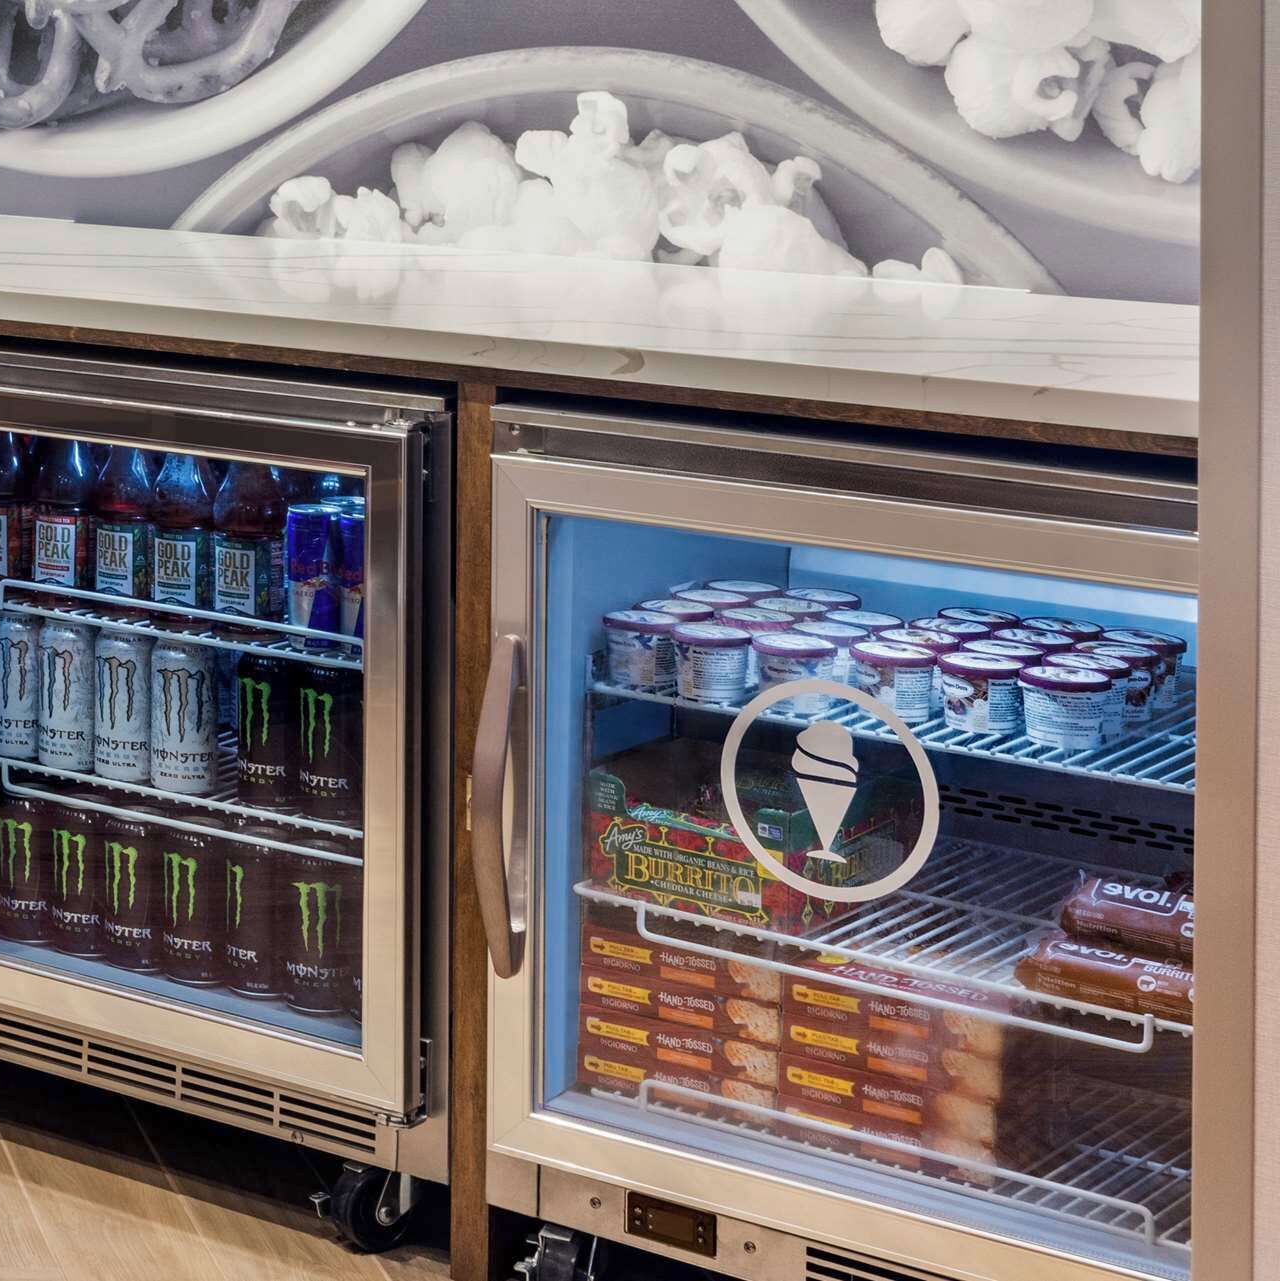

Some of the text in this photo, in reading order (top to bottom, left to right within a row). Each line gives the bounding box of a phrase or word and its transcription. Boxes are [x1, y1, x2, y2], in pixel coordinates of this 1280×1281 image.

[38, 522, 71, 545] GOLD
[97, 531, 129, 553] GOLD
[38, 539, 72, 561] PEAK
[97, 548, 129, 569] PEAK
[157, 540, 192, 563] GOLD
[157, 558, 191, 578] PEAK
[217, 550, 252, 573] GOLD
[217, 568, 251, 586] PEAK
[151, 746, 216, 765] MONSTER
[159, 770, 207, 782] ZERO ULTRA
[604, 827, 644, 852] Amy's
[632, 843, 651, 856] MADE
[652, 847, 673, 859] WITH
[624, 851, 757, 902] BURRITO
